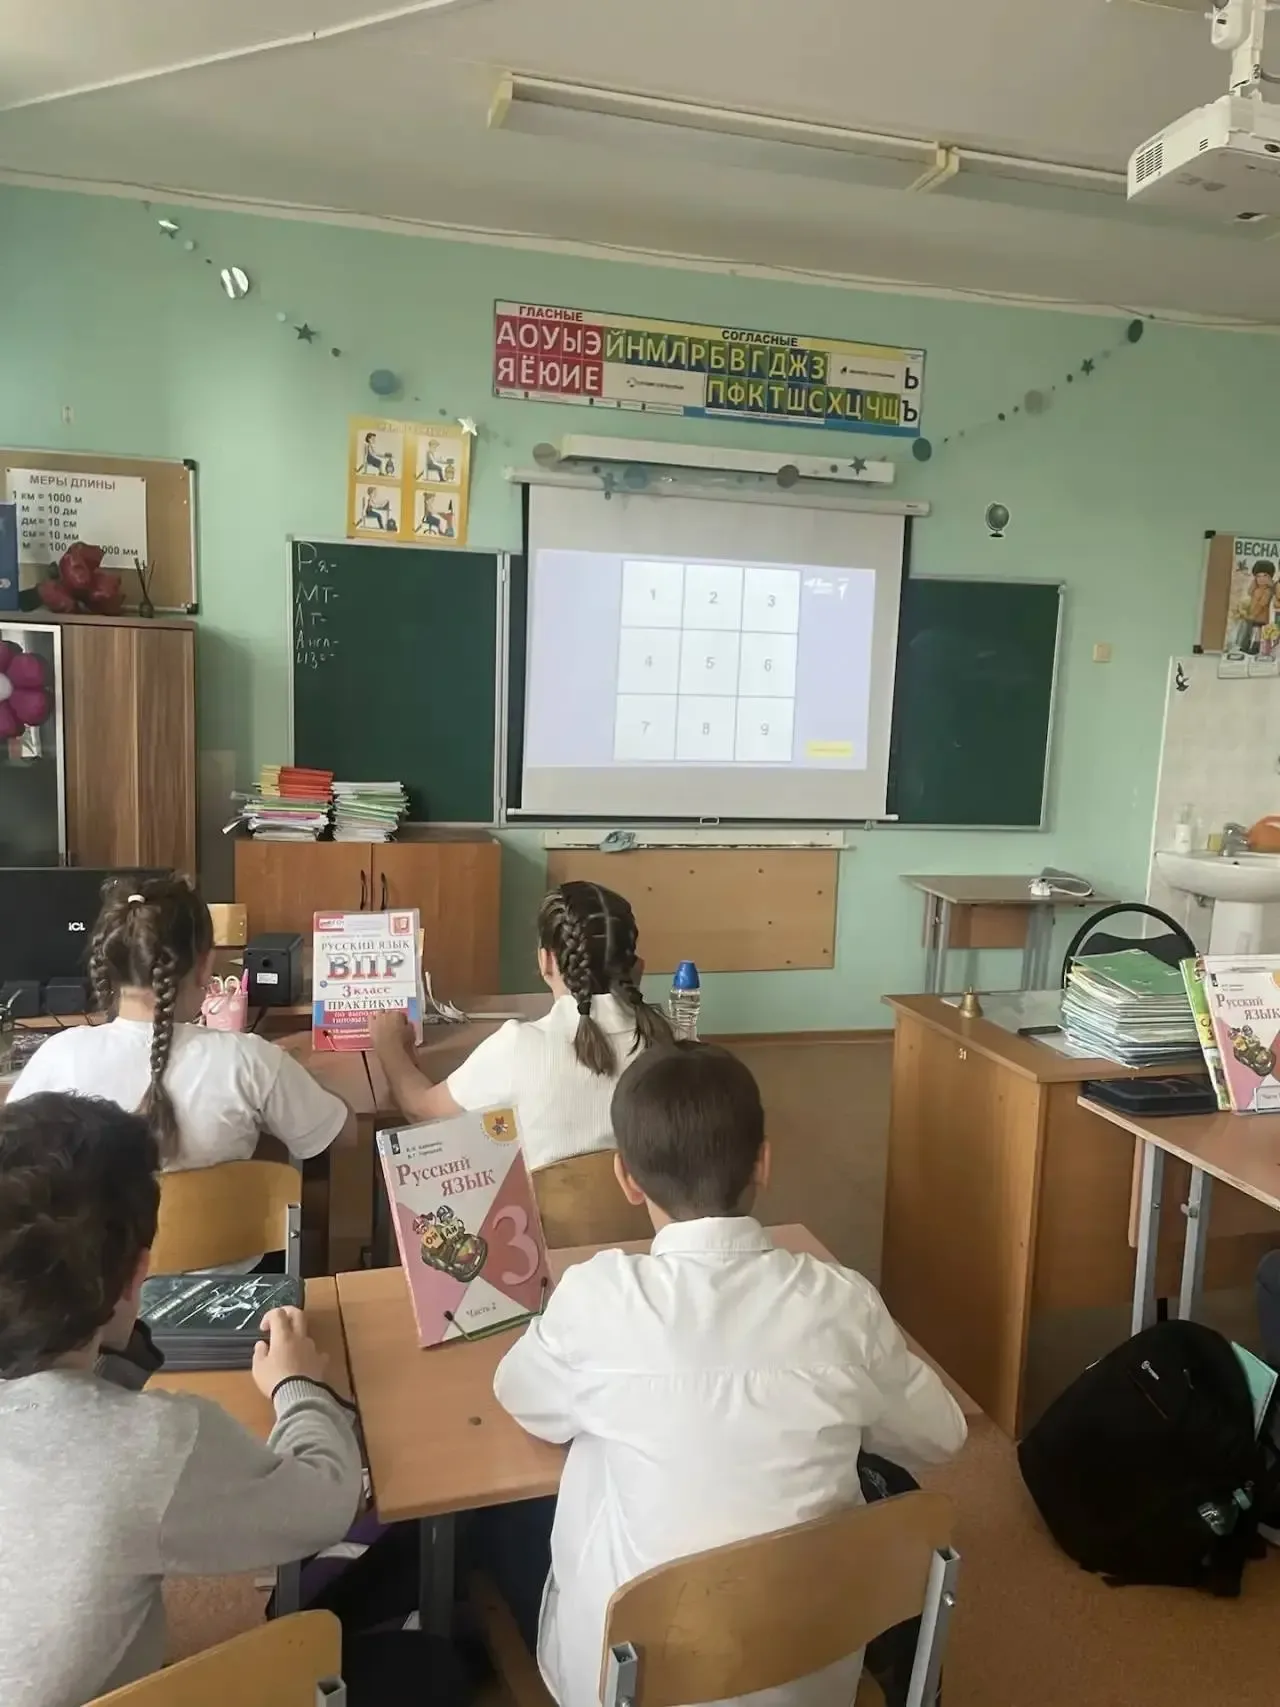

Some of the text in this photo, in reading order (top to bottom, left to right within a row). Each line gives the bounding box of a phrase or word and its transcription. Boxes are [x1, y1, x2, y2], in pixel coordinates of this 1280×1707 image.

[519, 306, 583, 322] ГЛАСНЫЕ
[722, 330, 798, 347] СОГЛАСНЫЕ
[30, 475, 115, 490] МЕРЫ ДЛИНЫ
[48, 493, 72, 503] 1000
[48, 506, 60, 515] 10
[48, 518, 60, 527] 10
[49, 531, 60, 540] 10
[101, 546, 119, 555] 000
[1235, 541, 1279, 558] ВЕСНА
[649, 588, 657, 601] 1
[709, 592, 718, 604] 2
[768, 594, 776, 607] 3
[706, 657, 715, 669] 5
[764, 658, 772, 672] 6
[641, 721, 650, 734] 7
[702, 722, 710, 735] 8
[760, 723, 769, 736] 9
[68, 922, 86, 931] ICL
[321, 940, 410, 951] РУССКИЙ ЯЗЫК
[326, 951, 405, 980] ВПР
[342, 984, 352, 998] 3
[328, 999, 404, 1010] ПРАКТИКУМ
[1216, 993, 1264, 1010] Русский
[396, 1155, 472, 1187] Русский
[492, 1205, 539, 1285] 3
